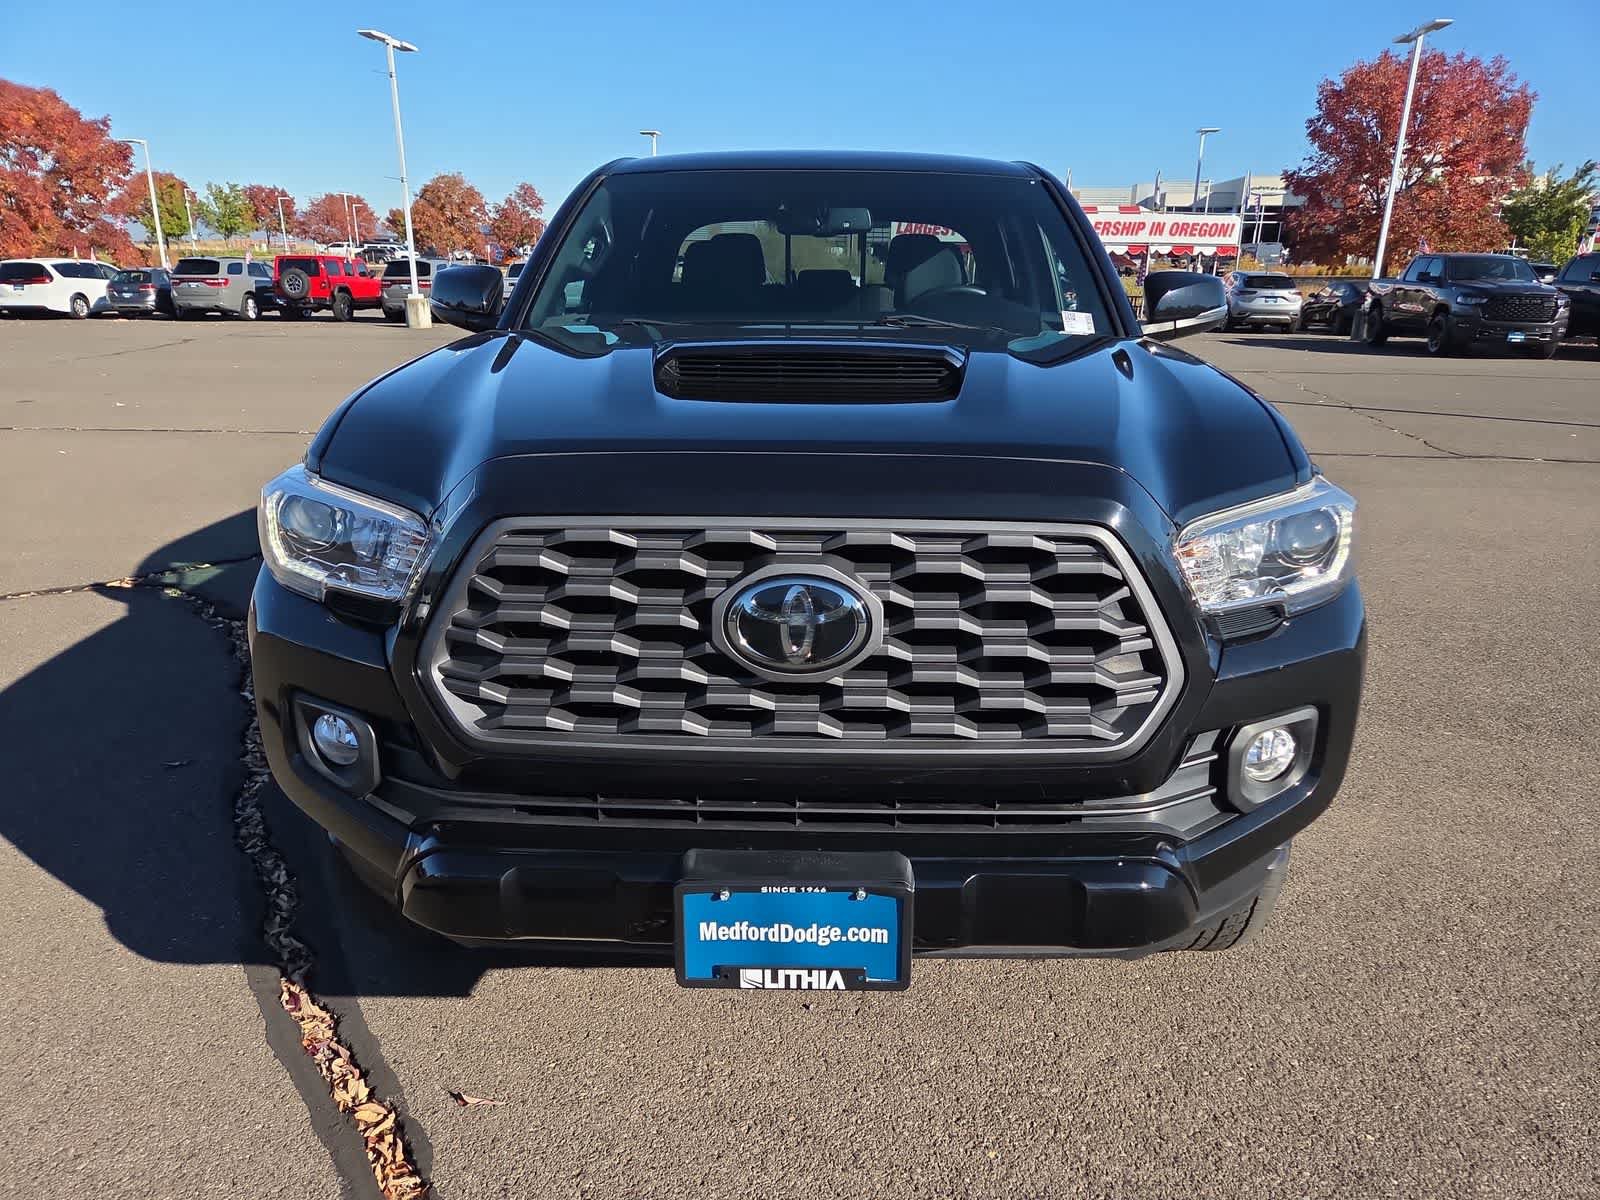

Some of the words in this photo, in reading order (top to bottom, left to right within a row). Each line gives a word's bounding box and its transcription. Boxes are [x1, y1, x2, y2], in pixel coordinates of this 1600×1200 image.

[1149, 222, 1167, 236] IN
[1169, 223, 1236, 238] OREGON!
[699, 922, 888, 946] MedfordDodge.com
[765, 969, 846, 989] LITHIA
